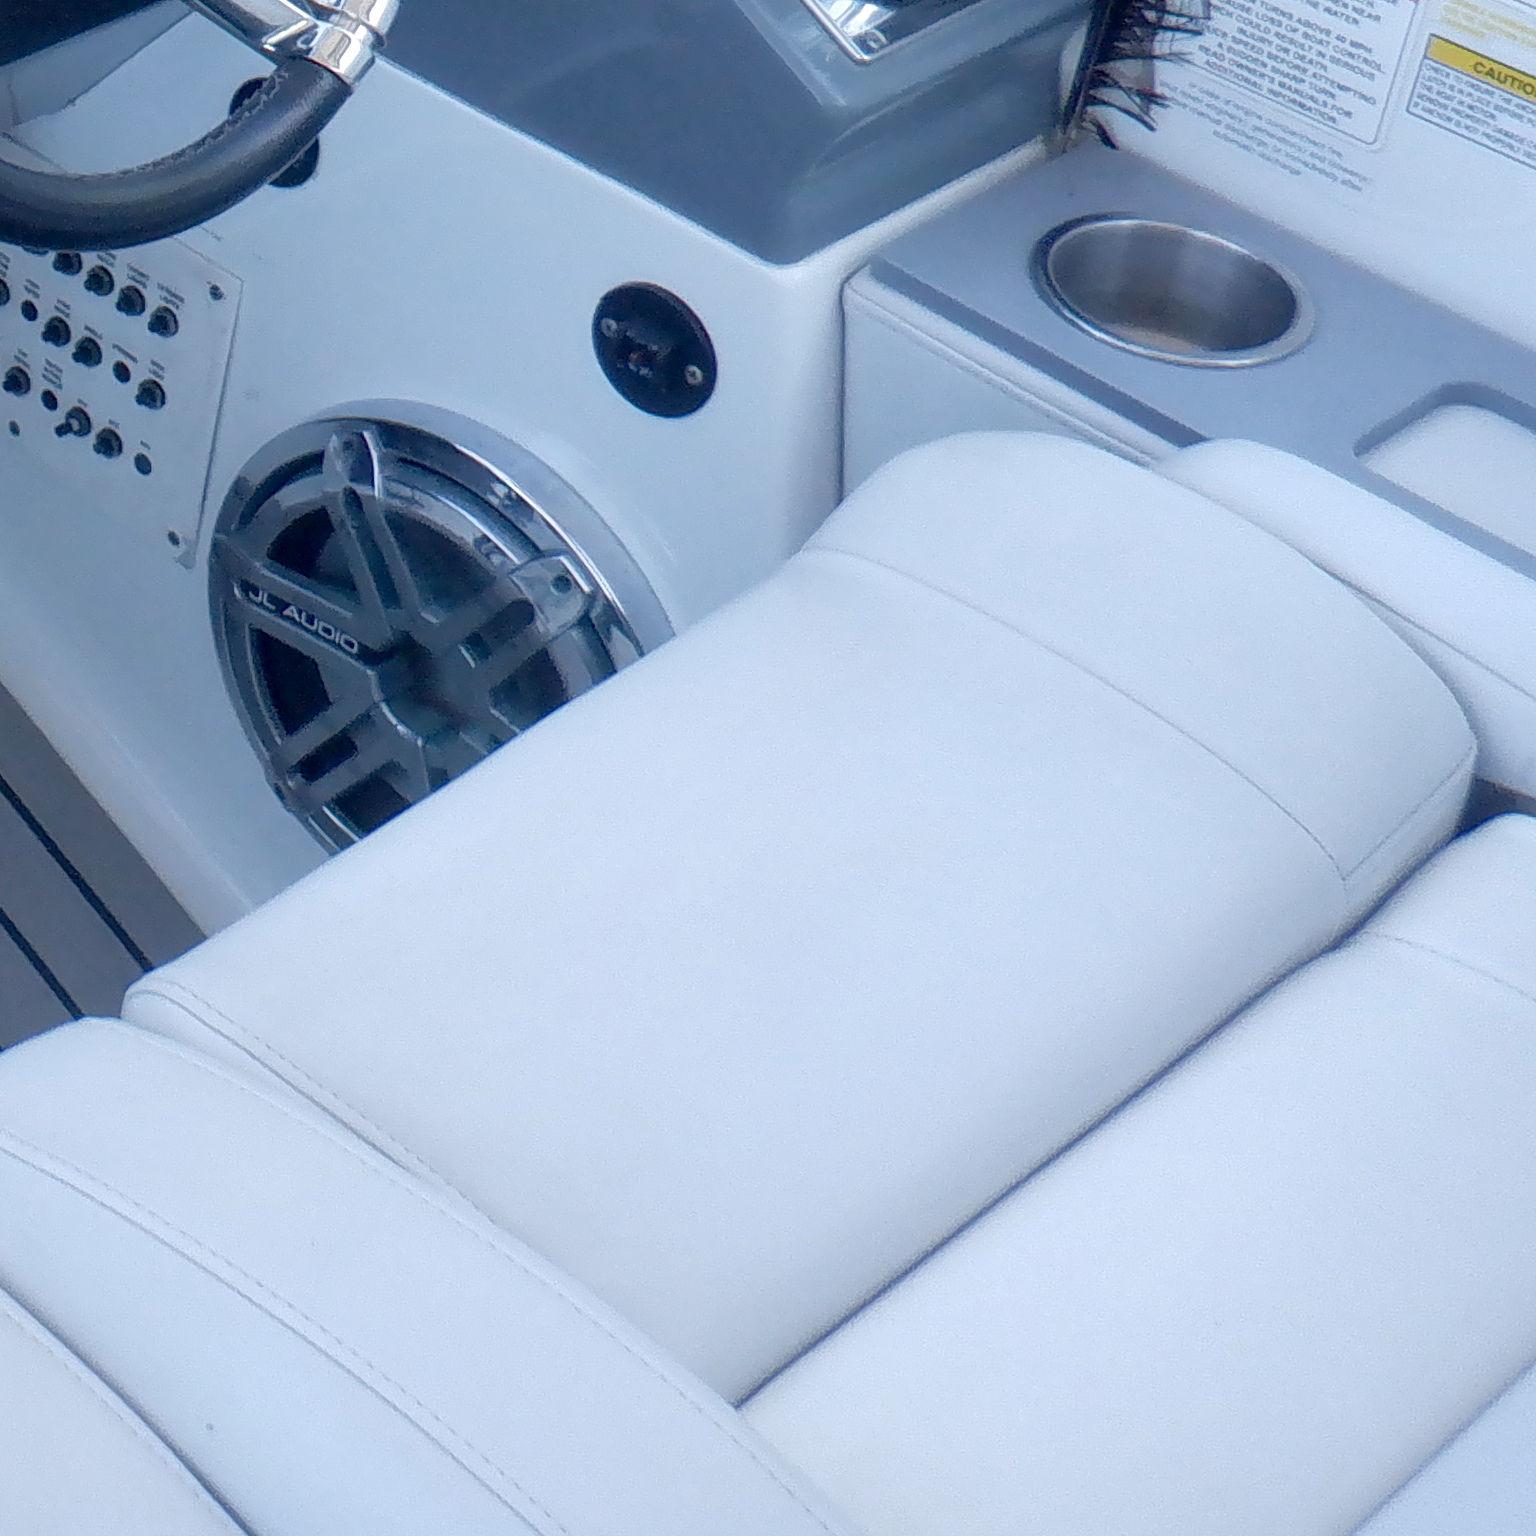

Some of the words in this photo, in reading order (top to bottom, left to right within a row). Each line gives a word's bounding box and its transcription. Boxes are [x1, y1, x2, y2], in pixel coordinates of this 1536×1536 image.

[1474, 62, 1536, 97] CAUTIO
[249, 588, 276, 610] JL
[282, 605, 359, 654] AUDIO
